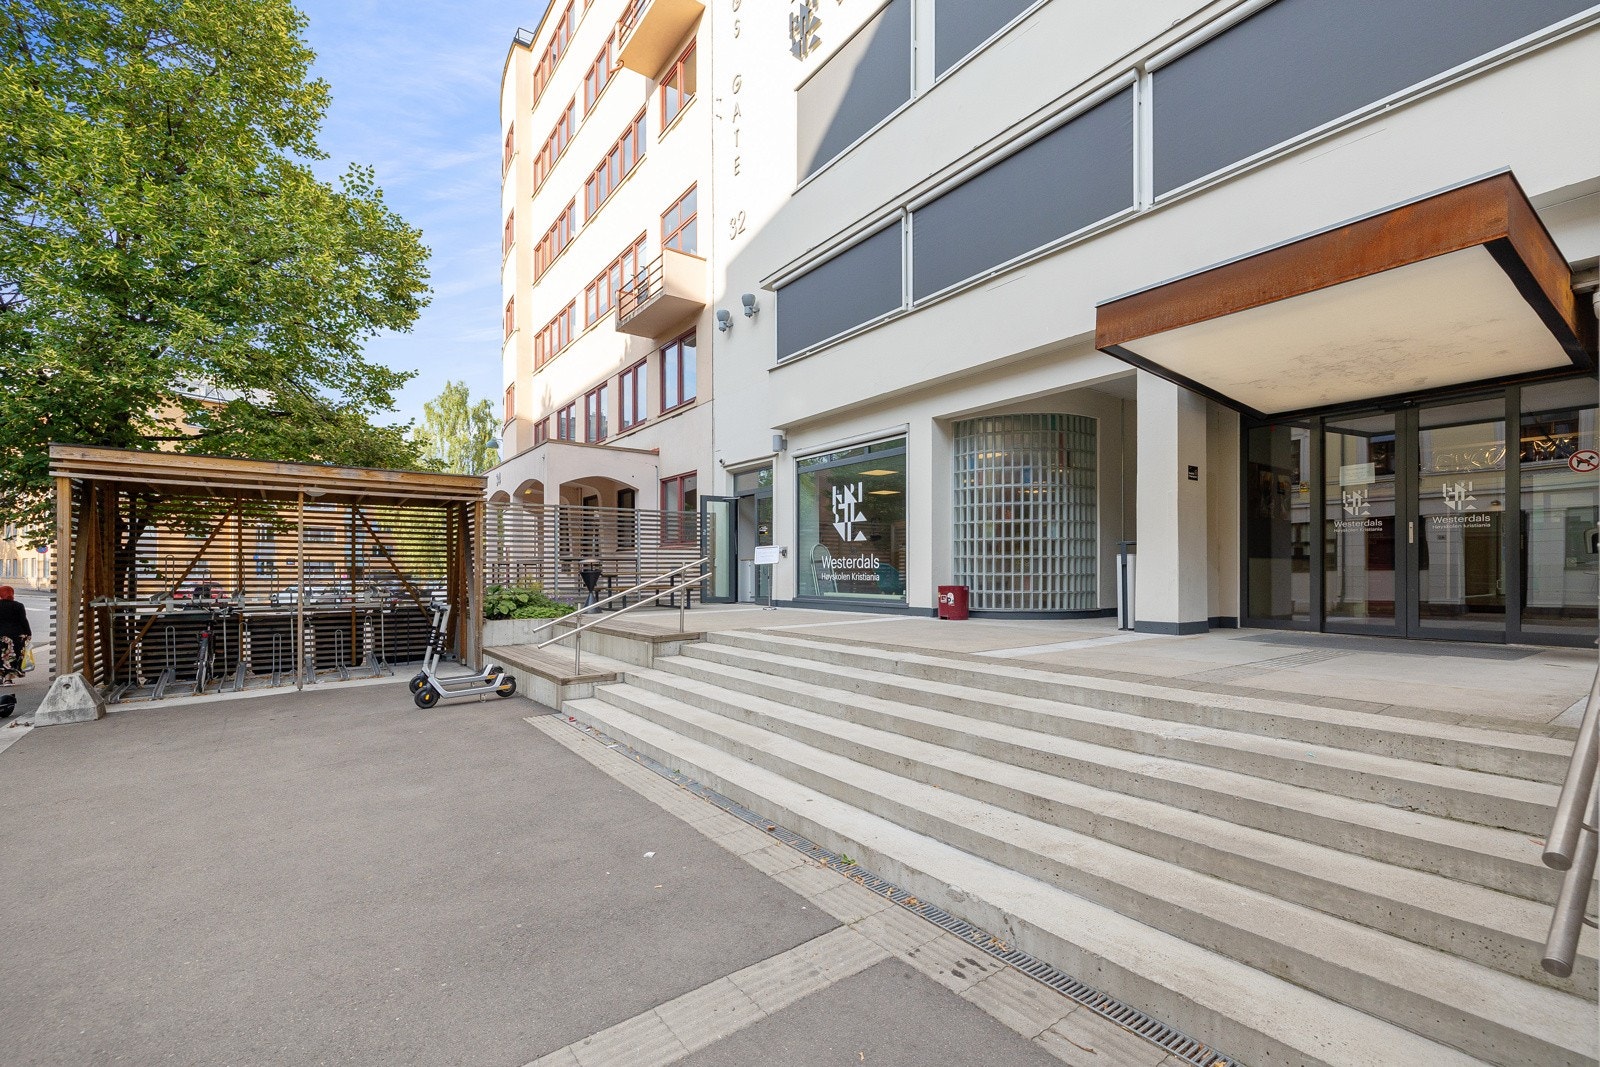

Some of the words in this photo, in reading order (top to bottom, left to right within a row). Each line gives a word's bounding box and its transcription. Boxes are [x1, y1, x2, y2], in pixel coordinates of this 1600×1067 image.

[732, 74, 742, 177] GATE
[729, 209, 746, 241] 32
[1333, 518, 1383, 528] Westerdals
[1432, 513, 1491, 524] Westerdals
[821, 553, 880, 569] Westerdals
[851, 571, 880, 581] Kristiania
